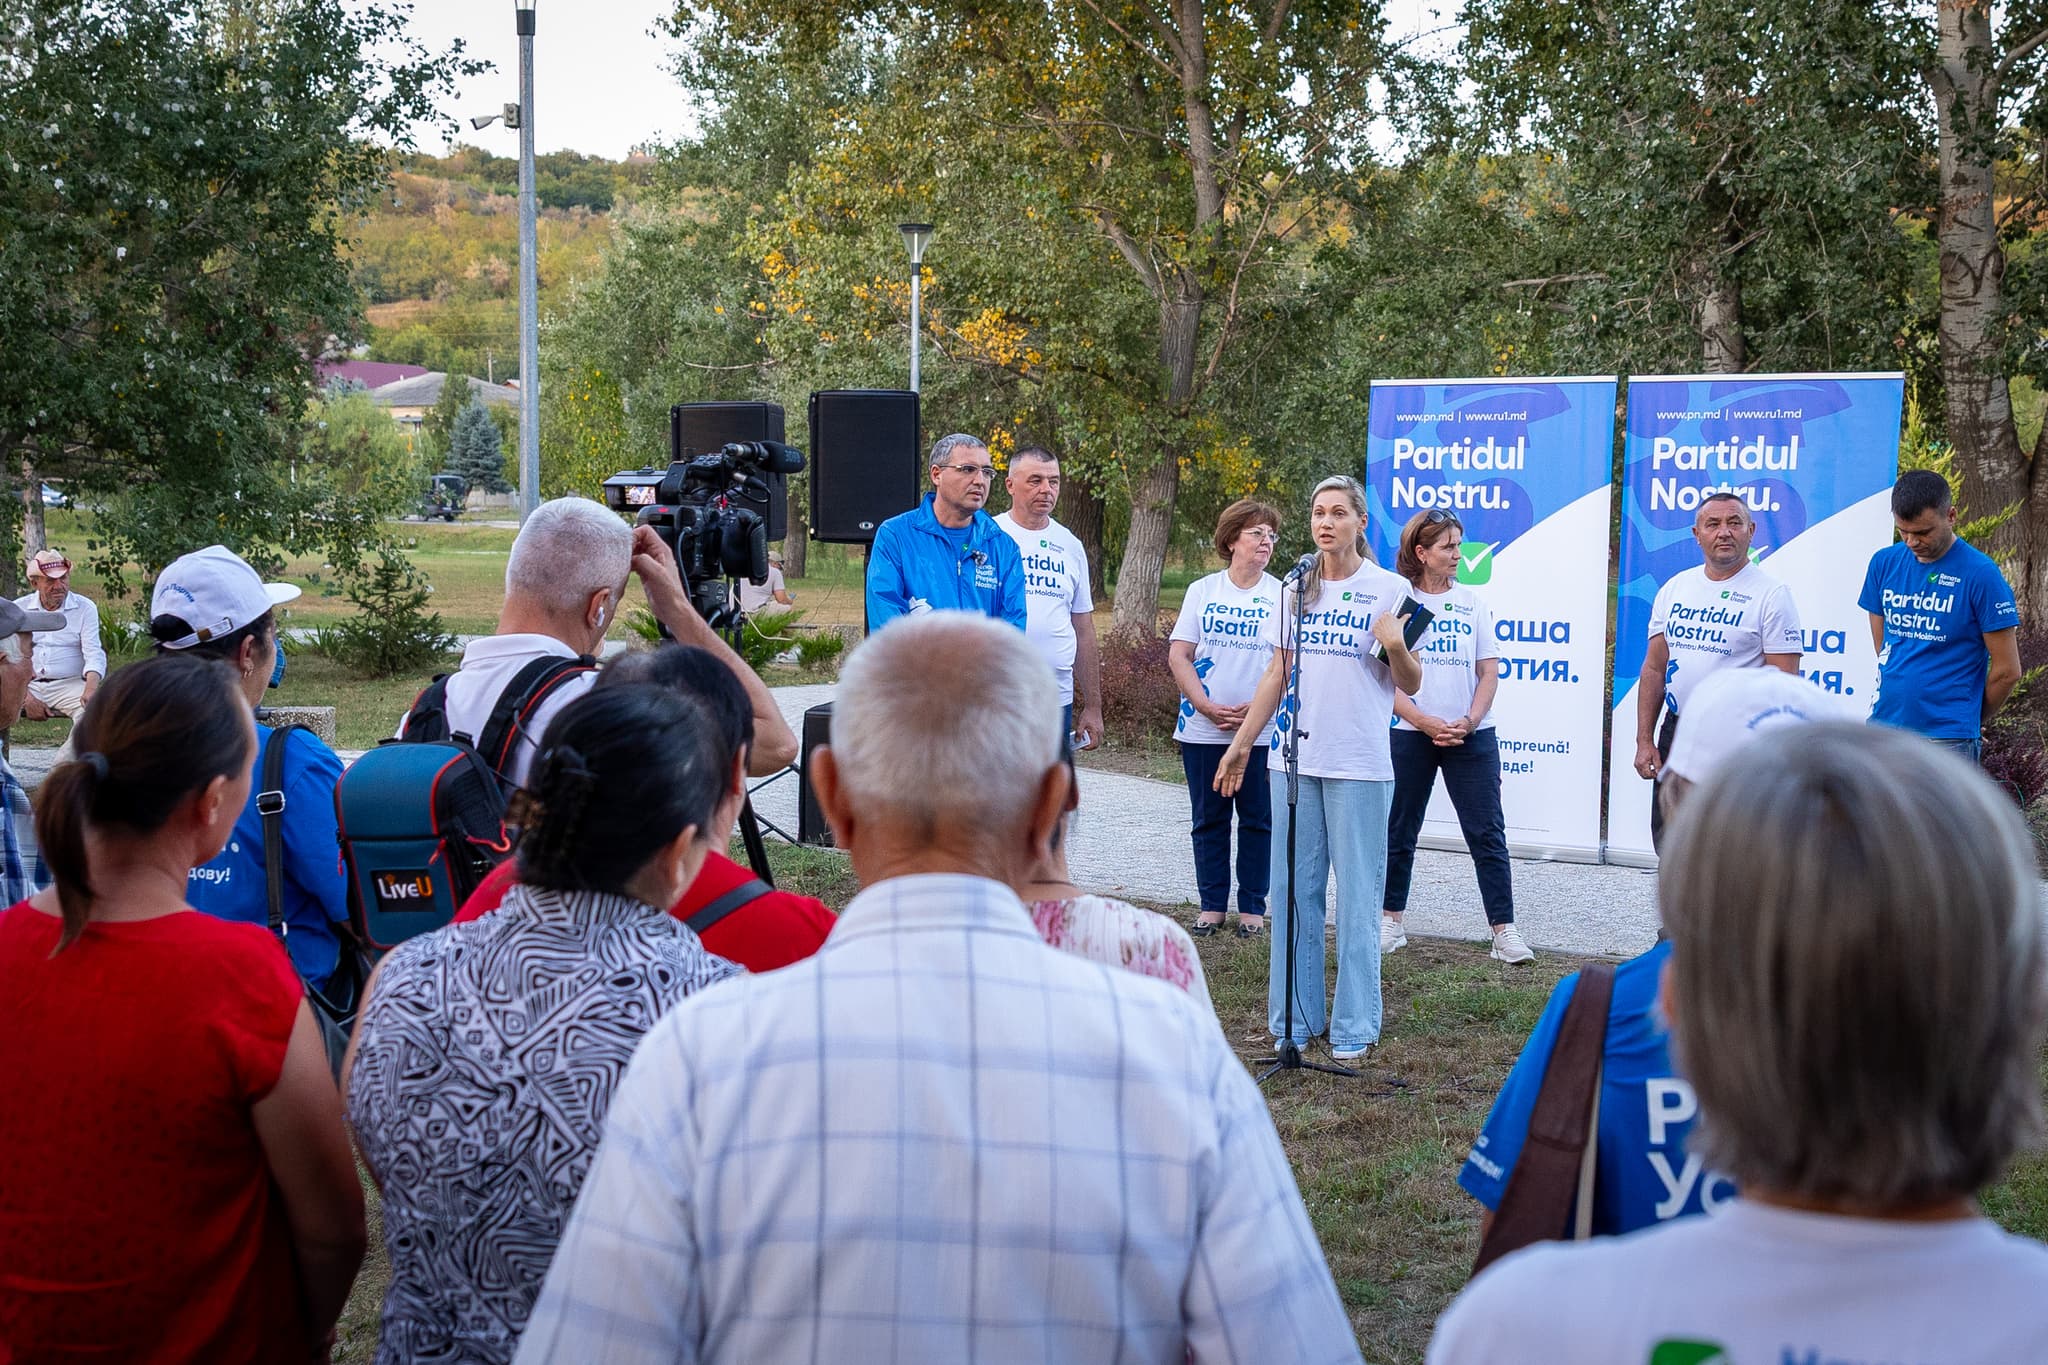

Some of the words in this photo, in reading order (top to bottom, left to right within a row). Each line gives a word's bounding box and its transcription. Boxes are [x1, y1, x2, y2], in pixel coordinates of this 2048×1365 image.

[1396, 412, 1454, 424] www.pn.md
[1465, 411, 1527, 422] www.ru1.md
[1656, 409, 1721, 421] www.pn.md
[1733, 408, 1802, 420] www.ru1.md
[1393, 437, 1525, 470] Partidul
[1652, 435, 1799, 470] Partidul
[1391, 476, 1511, 509] Nostru.
[1882, 589, 1955, 613] Partidul
[1298, 609, 1371, 631] artidul
[1669, 603, 1744, 627] Partidul
[1295, 630, 1359, 648] ostru.
[1495, 619, 1570, 644] аша
[1666, 620, 1728, 643] Nostru.
[1497, 738, 1570, 754] mpreună!
[378, 874, 432, 899] LiveU
